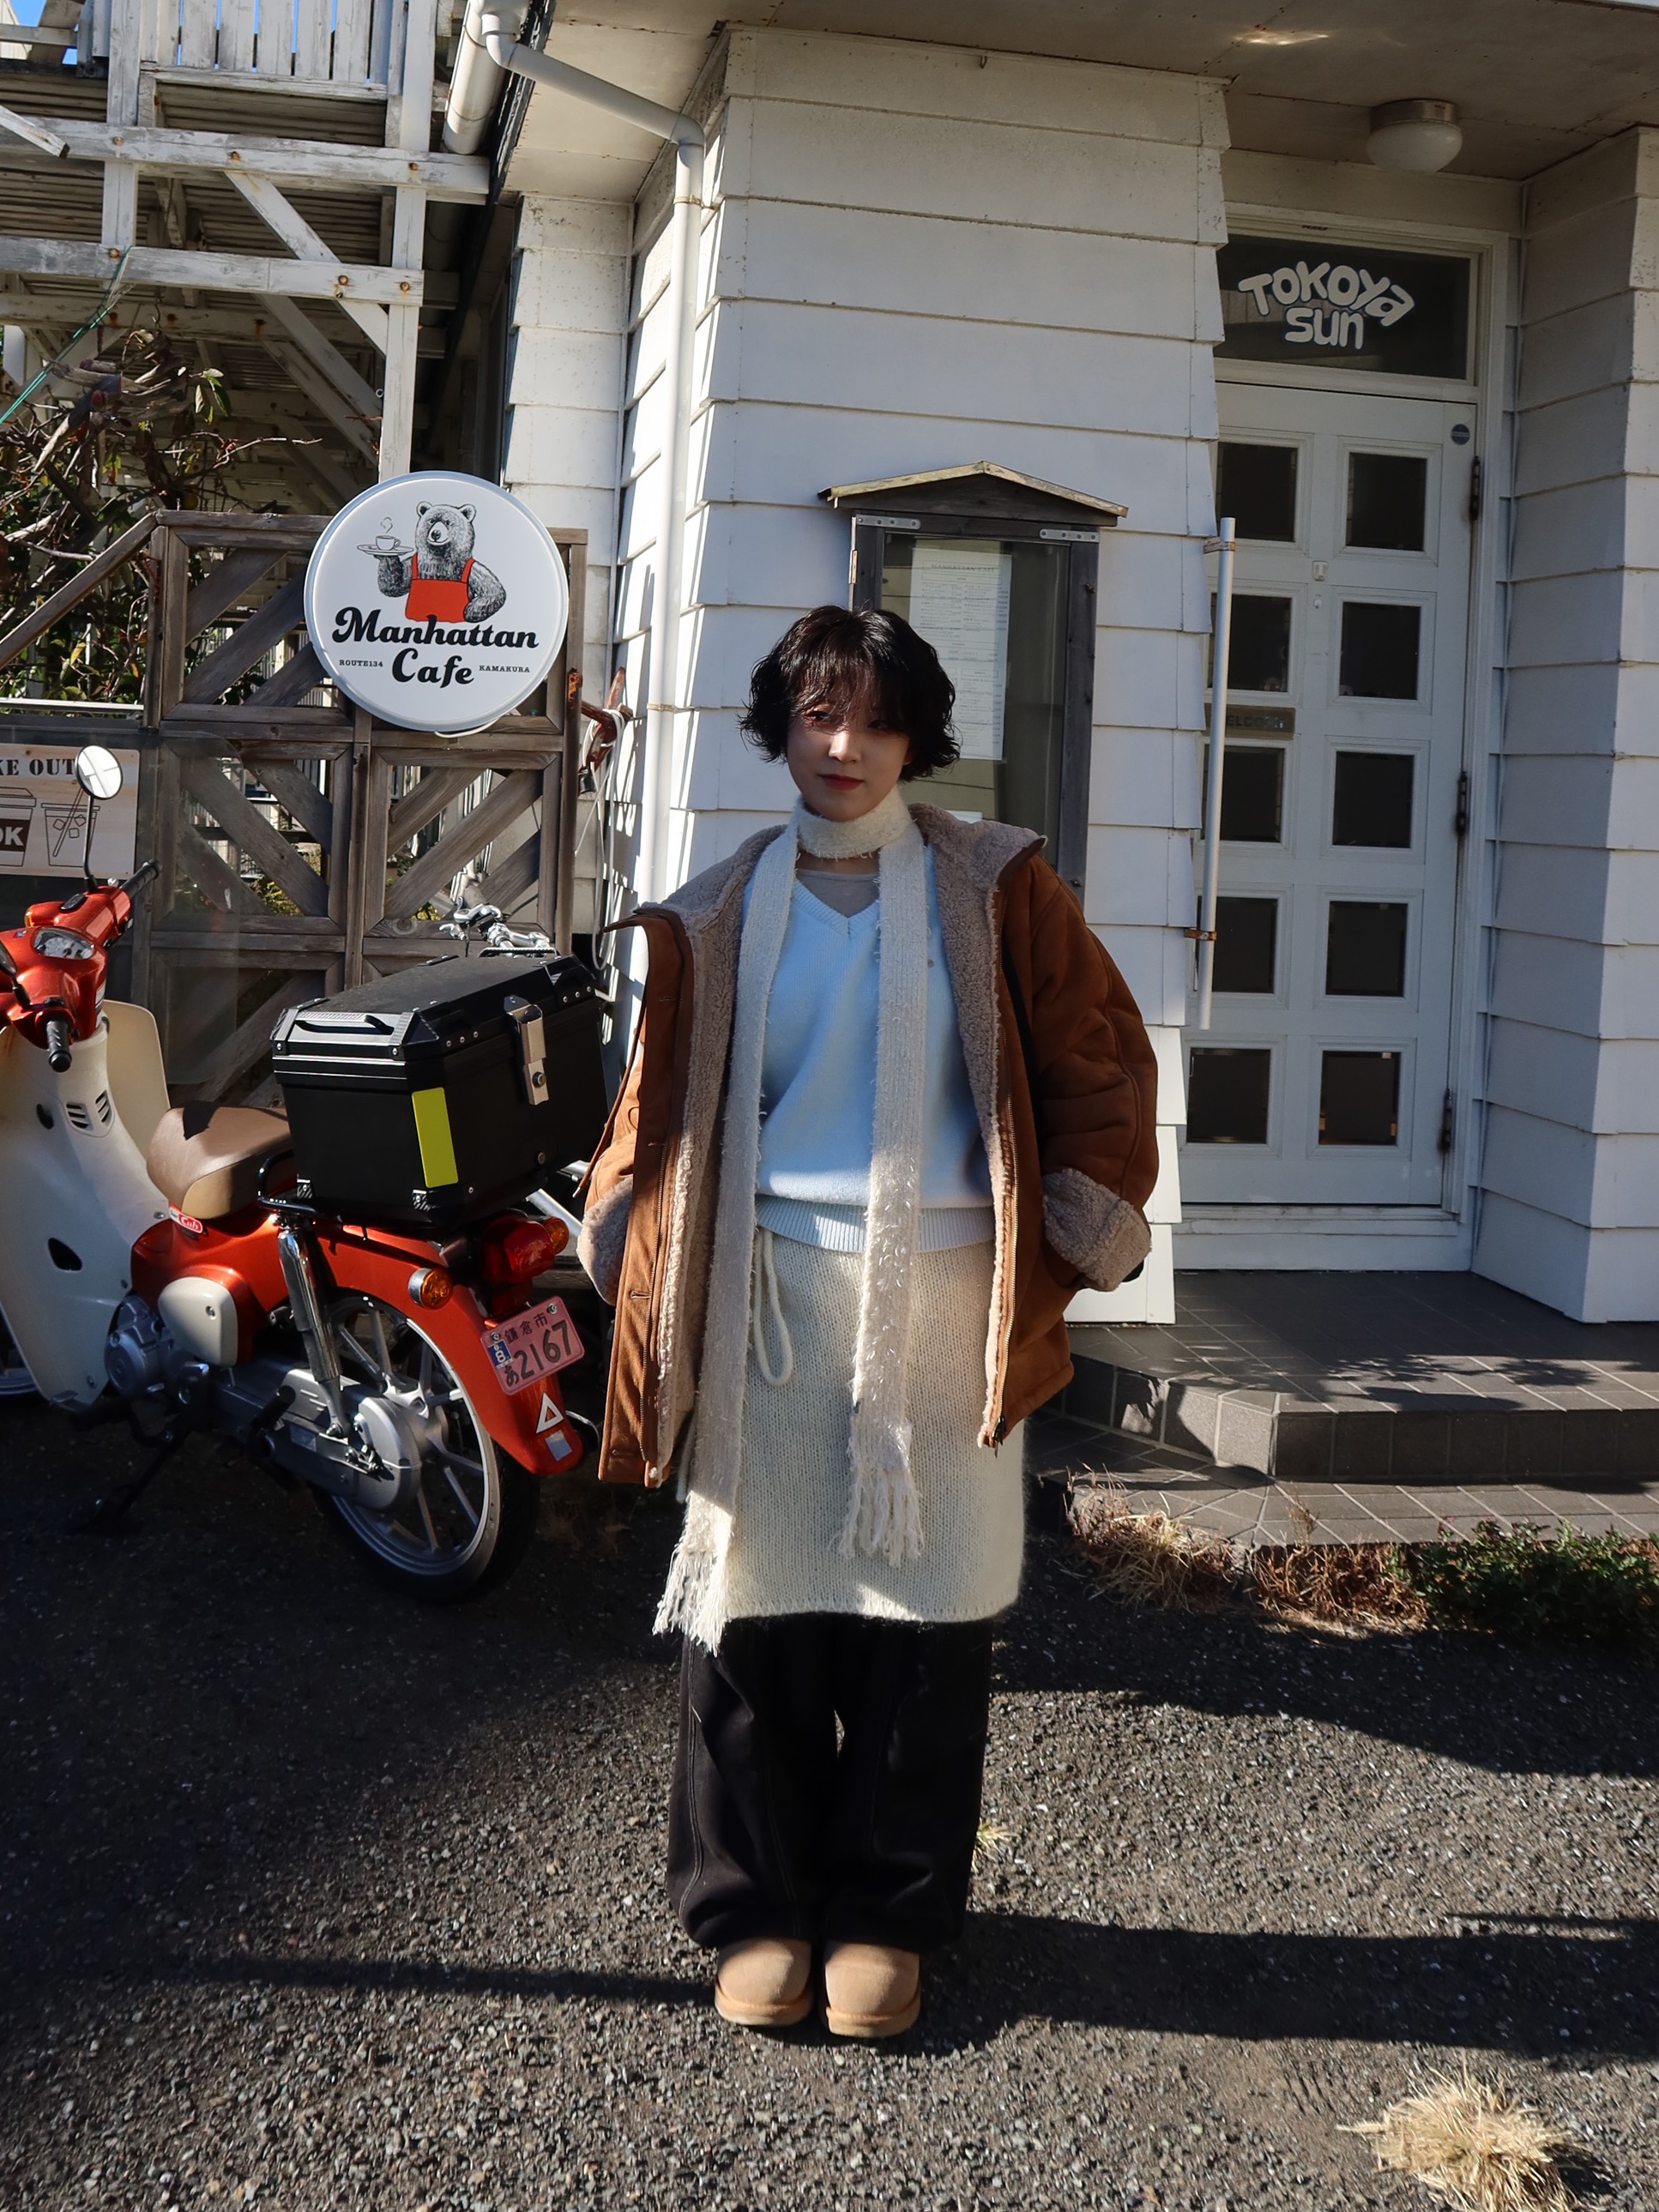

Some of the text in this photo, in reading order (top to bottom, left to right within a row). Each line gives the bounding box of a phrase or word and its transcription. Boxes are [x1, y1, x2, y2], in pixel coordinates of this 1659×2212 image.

[332, 606, 540, 648] Manhattan
[339, 659, 383, 667] ROUTE134
[392, 648, 474, 688] Cafe
[29, 758, 75, 775] OUT
[0, 826, 24, 847] K
[514, 1319, 572, 1380] 2167
